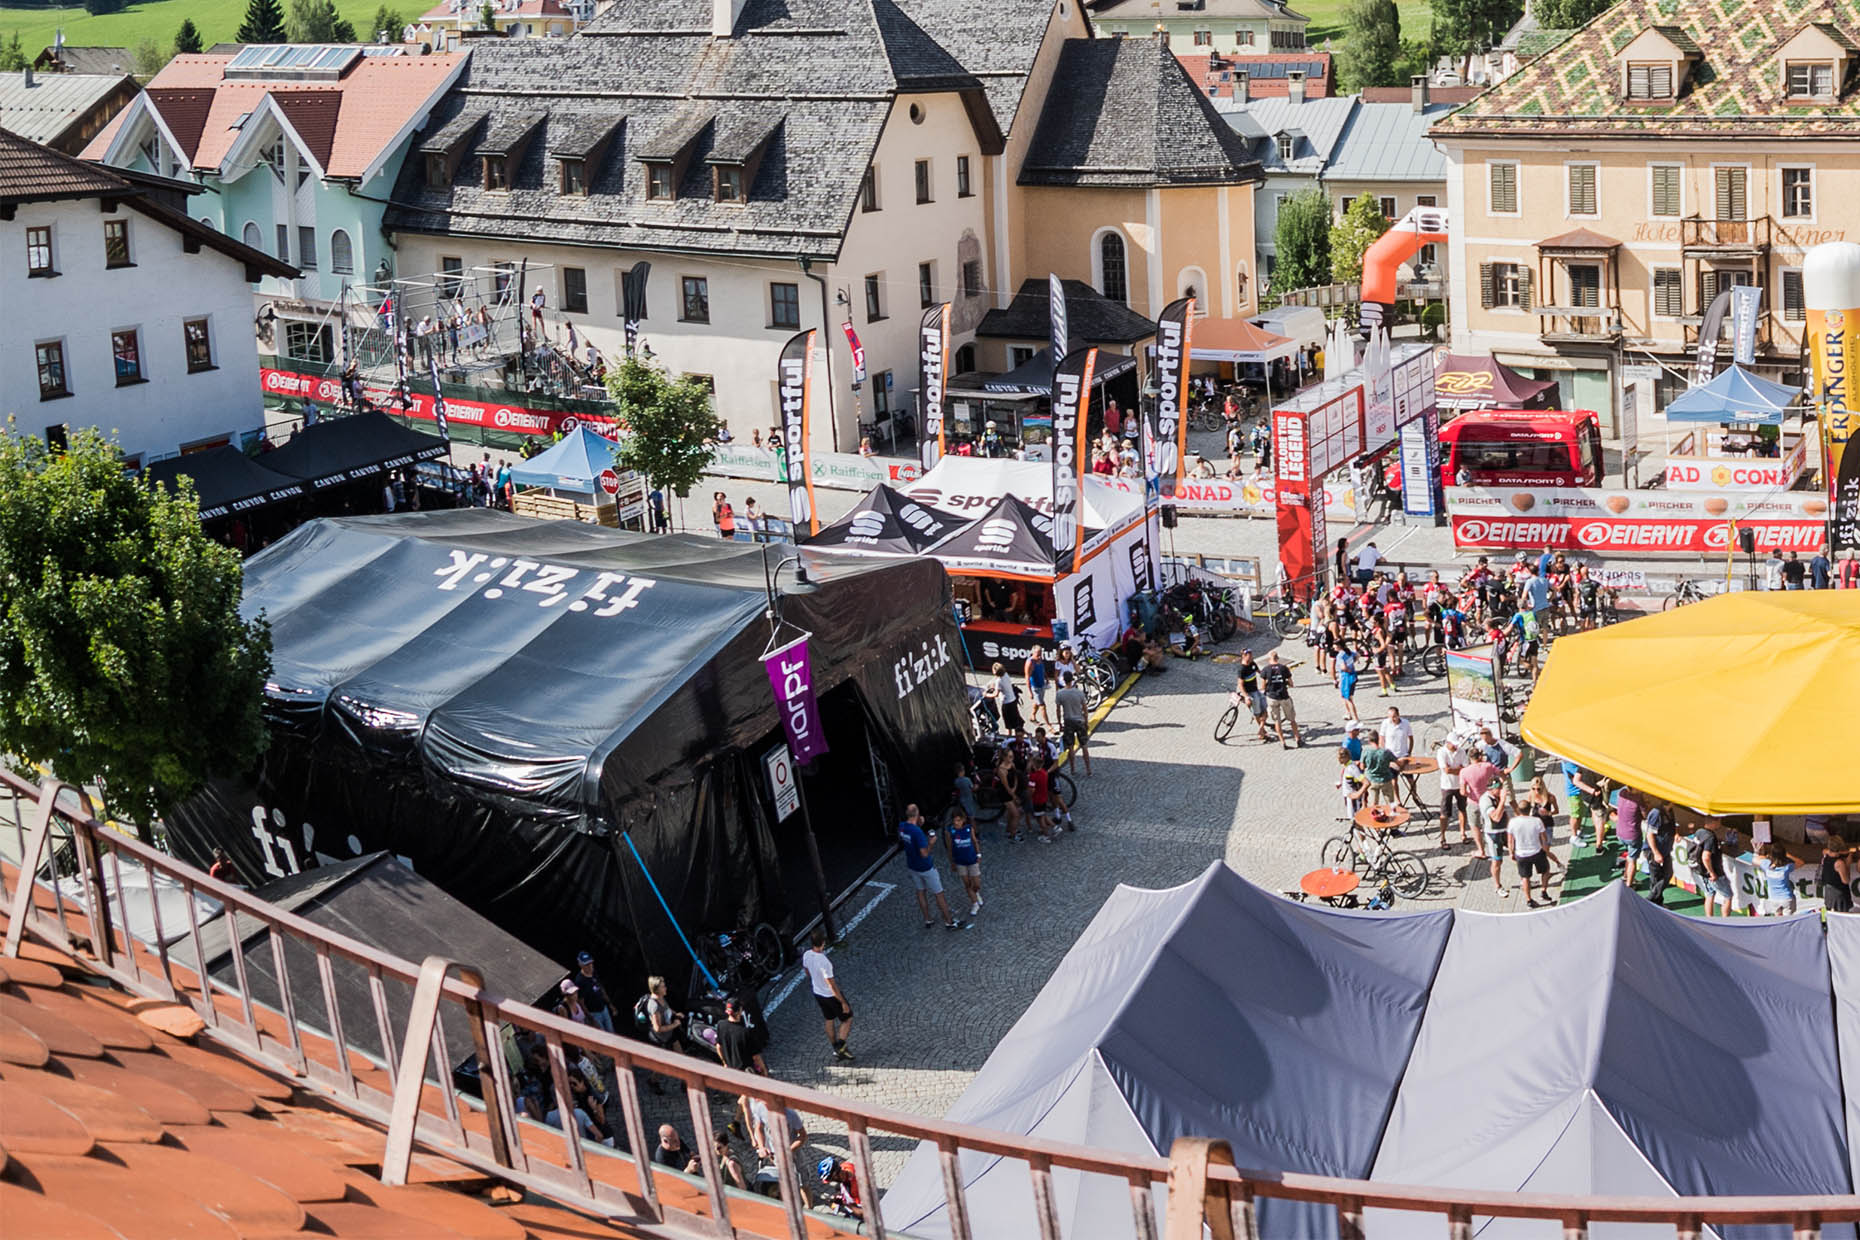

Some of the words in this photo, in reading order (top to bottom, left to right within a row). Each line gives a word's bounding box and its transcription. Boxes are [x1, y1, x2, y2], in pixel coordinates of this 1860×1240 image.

[1632, 222, 1683, 241] Hotel
[1775, 225, 1846, 246] Ebner
[922, 326, 945, 435] sportful
[1158, 319, 1182, 436] sportful
[1027, 385, 1052, 395] CANY
[1829, 329, 1850, 444] ERDINGER
[445, 404, 485, 422] ENERVIT
[510, 413, 550, 430] ENERVIT
[781, 358, 804, 483] sportful
[1278, 415, 1287, 434] THE
[1054, 373, 1081, 506] sportful
[417, 445, 447, 460] CANYON
[1278, 434, 1289, 480] EXPLORE
[1287, 416, 1305, 481] LEGEND
[384, 454, 414, 470] CANYON
[721, 453, 771, 469] Raiffeisen
[350, 463, 381, 479] CANYON
[830, 464, 884, 481] Raiffeisen
[314, 472, 346, 488] CANYON
[601, 476, 618, 488] STOP
[270, 485, 302, 501] CANYON
[1160, 485, 1233, 502] CONAD
[1458, 497, 1501, 505] PIRCHER
[233, 495, 266, 511] CANYON
[1552, 498, 1596, 507] PIRCHER
[1648, 501, 1693, 510] PIRCHER
[1747, 502, 1792, 511] PIRCHER
[1839, 476, 1860, 545] fi'zi:k
[844, 534, 879, 545] sportful
[1488, 523, 1571, 544] ENERVIT
[1609, 525, 1698, 545] ENERVIT
[974, 542, 1011, 554] sportful
[434, 549, 657, 617] fi'zi:k
[1001, 644, 1057, 662] sporful
[895, 634, 950, 699] fi'zi:k
